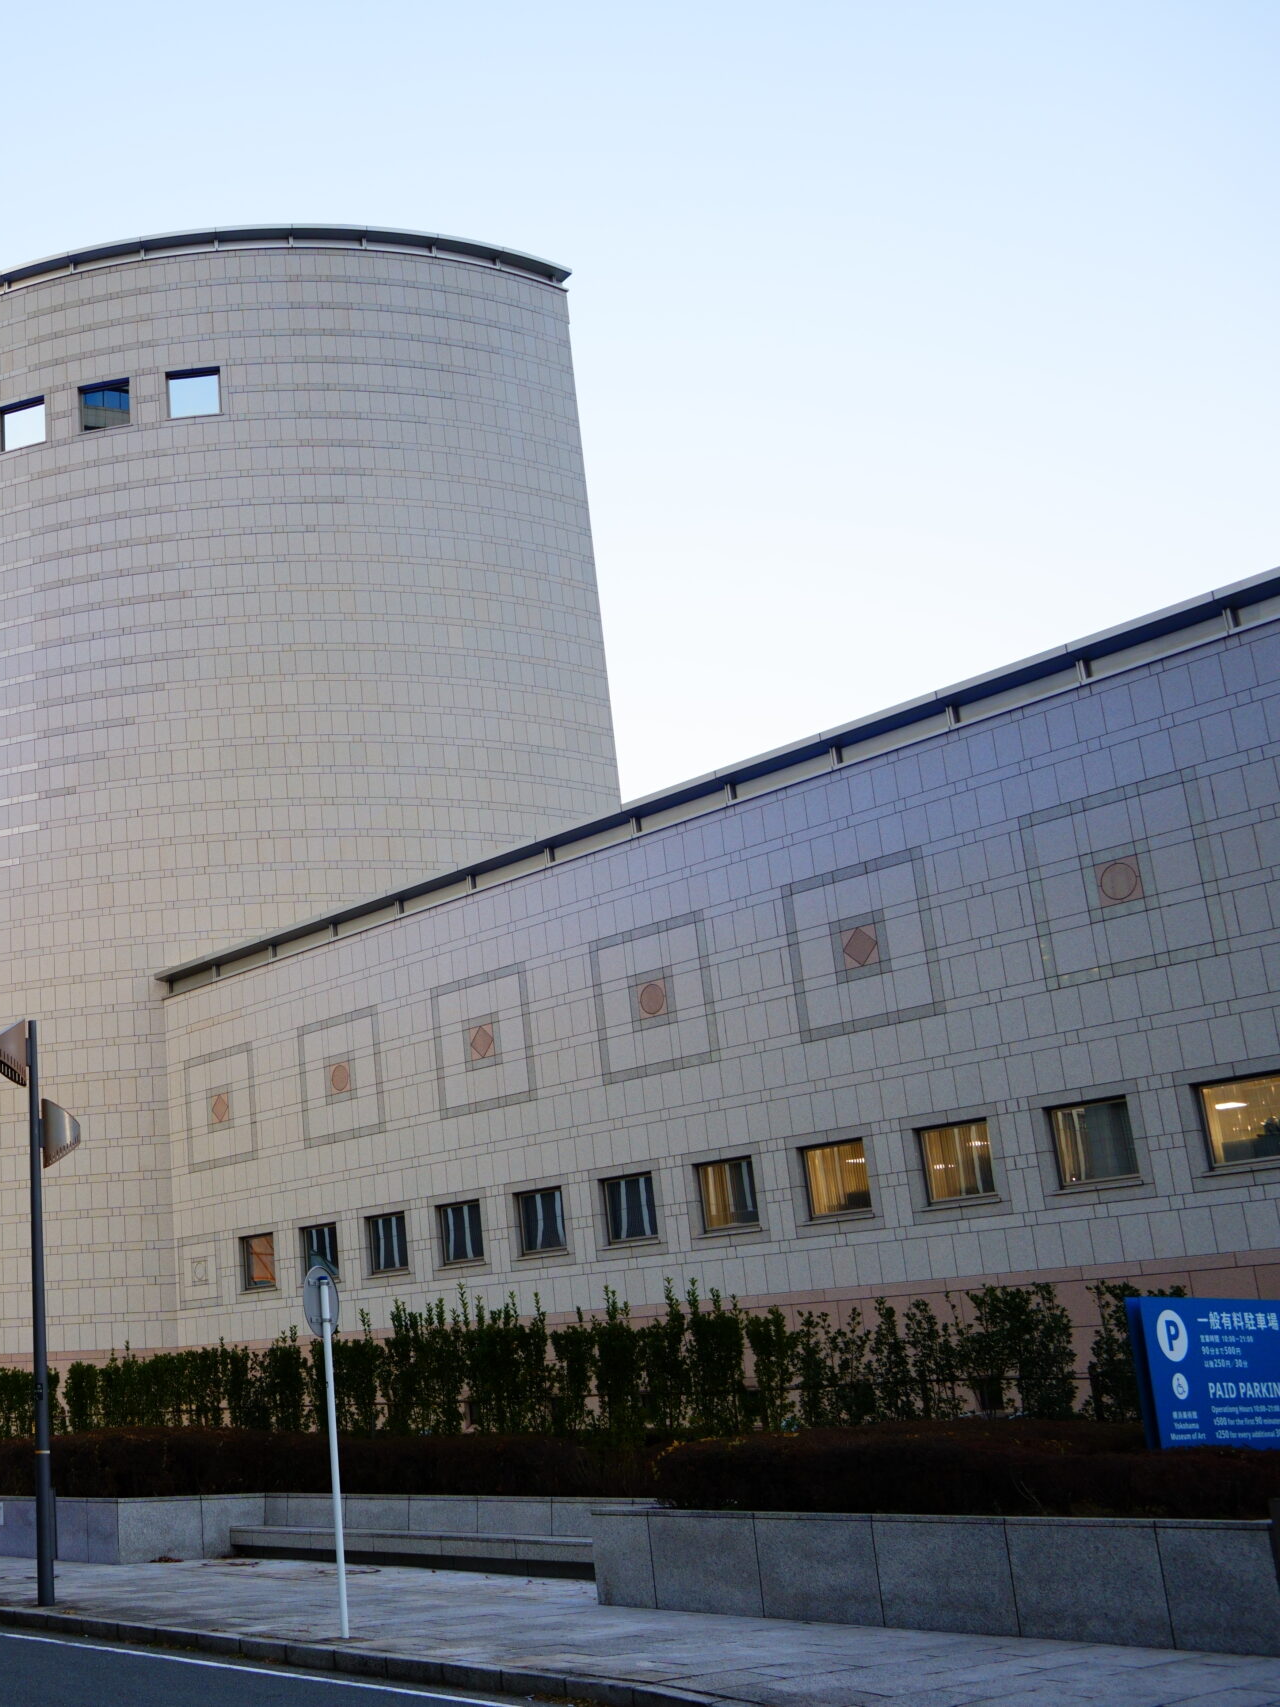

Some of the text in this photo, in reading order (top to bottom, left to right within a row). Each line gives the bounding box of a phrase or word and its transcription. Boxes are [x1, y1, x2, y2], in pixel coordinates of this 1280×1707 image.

[1196, 1311, 1279, 1331] 一般有料駐車場
[1165, 1319, 1180, 1352] P
[1201, 1346, 1242, 1356] 90分まで500円
[1208, 1382, 1237, 1398] PAID
[1239, 1405, 1253, 1413] Hours
[1173, 1421, 1200, 1429] Yokohama
[1235, 1417, 1244, 1425] the
[1244, 1417, 1255, 1425] first
[1254, 1416, 1263, 1425] 90
[1170, 1431, 1206, 1440] Museum of Art
[1237, 1432, 1251, 1440] every
